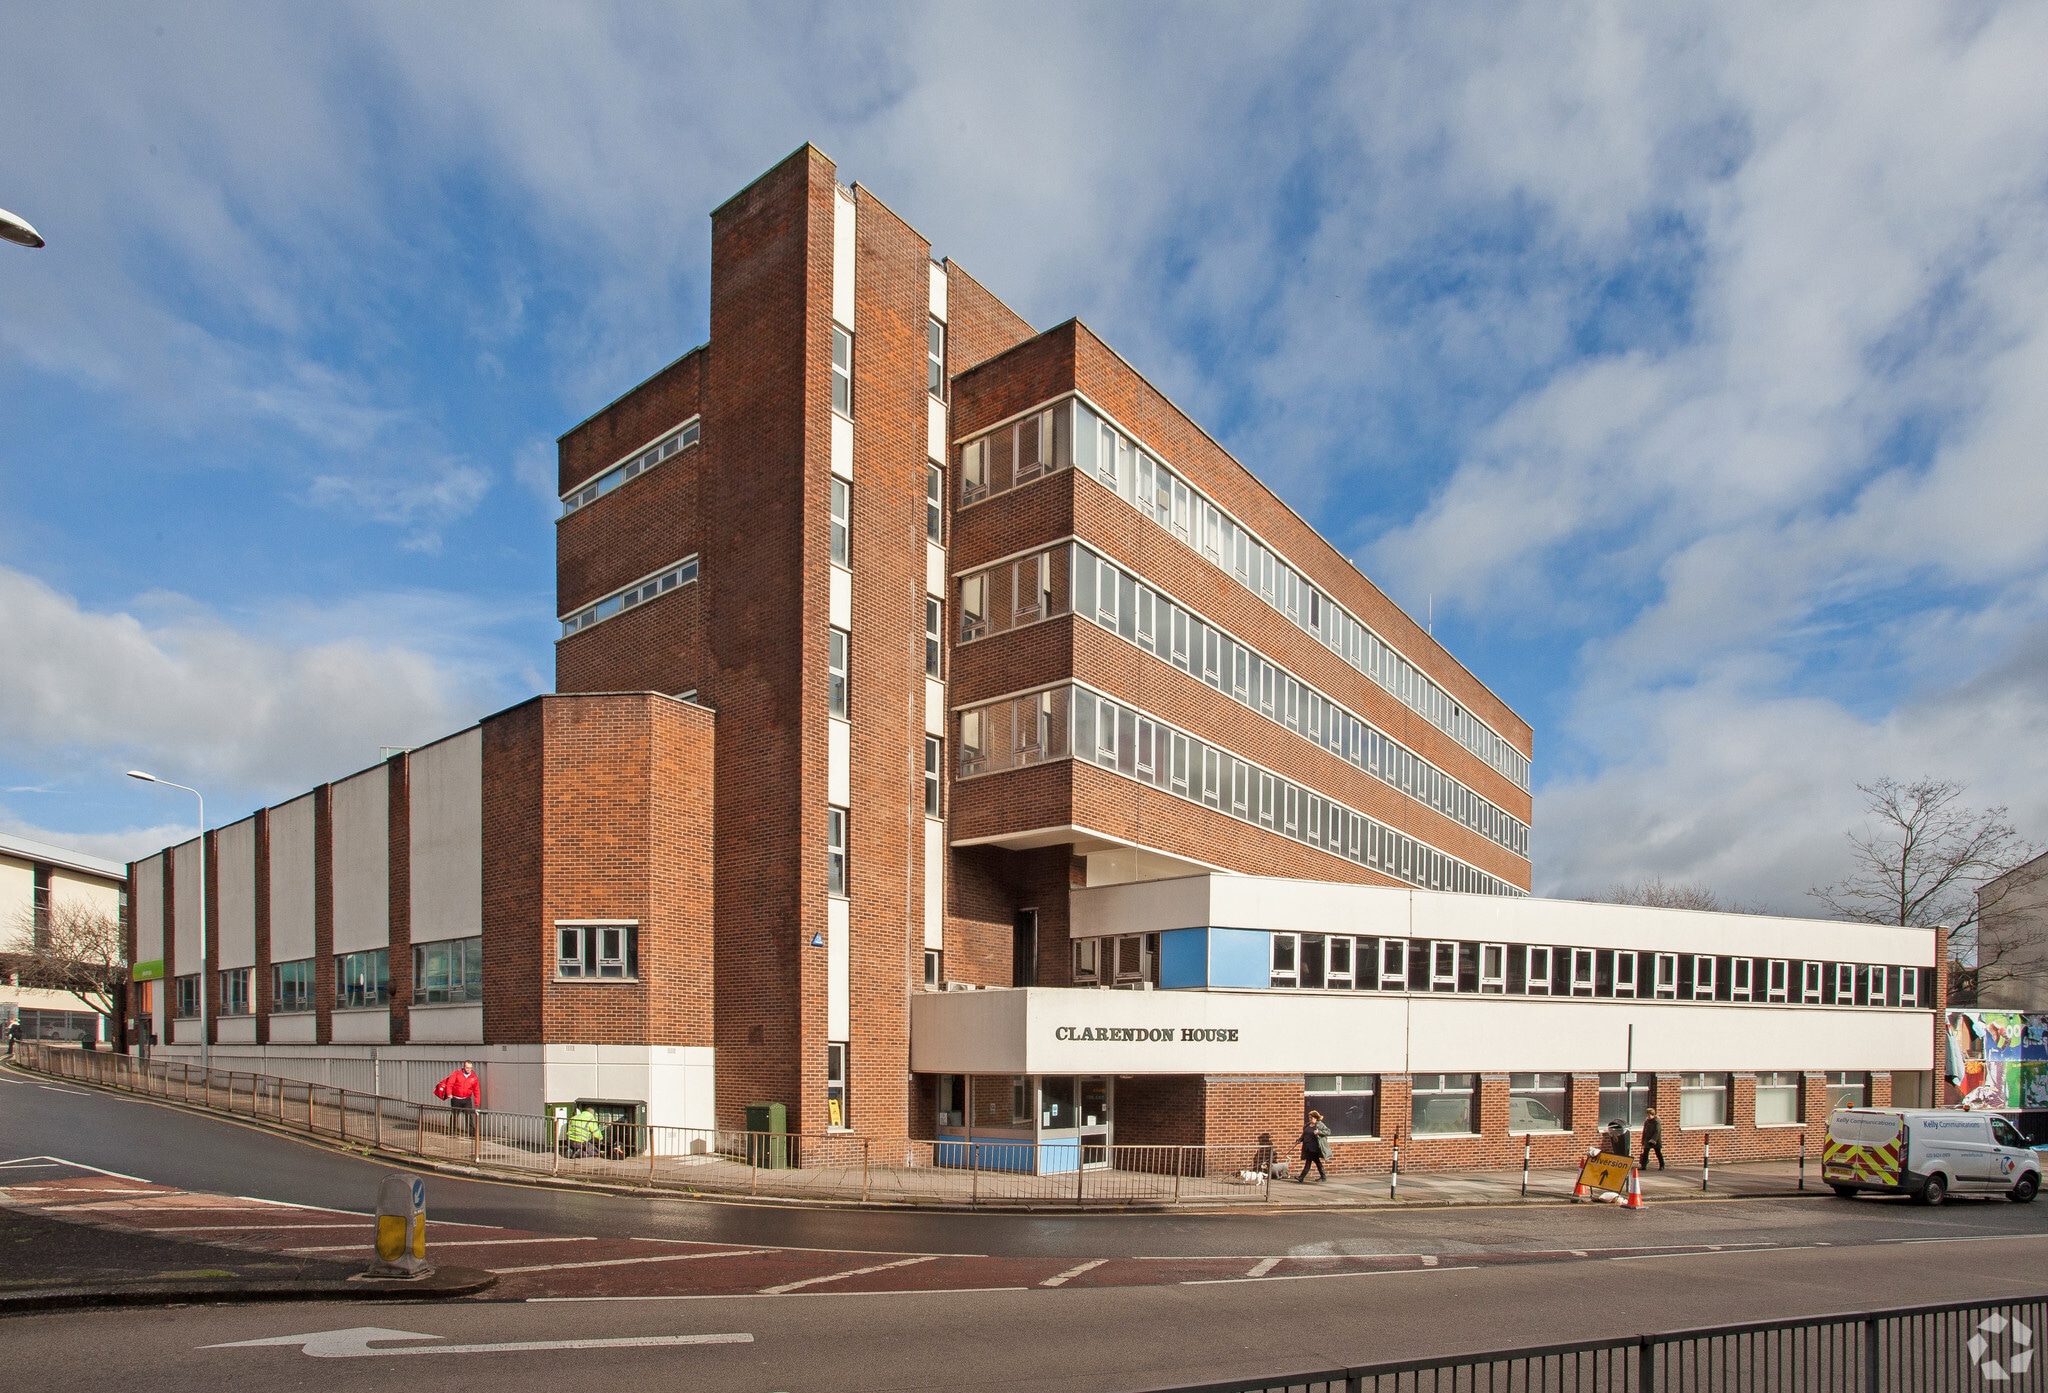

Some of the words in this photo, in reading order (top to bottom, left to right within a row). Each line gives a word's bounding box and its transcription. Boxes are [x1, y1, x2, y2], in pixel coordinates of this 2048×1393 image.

[1055, 1026, 1175, 1042] CLARENDON
[1180, 1028, 1239, 1042] HOUSE
[1836, 1117, 1850, 1125] Kelly
[1850, 1118, 1896, 1127] Communications
[1923, 1120, 1939, 1130] Kelly
[1939, 1121, 1980, 1129] Communications
